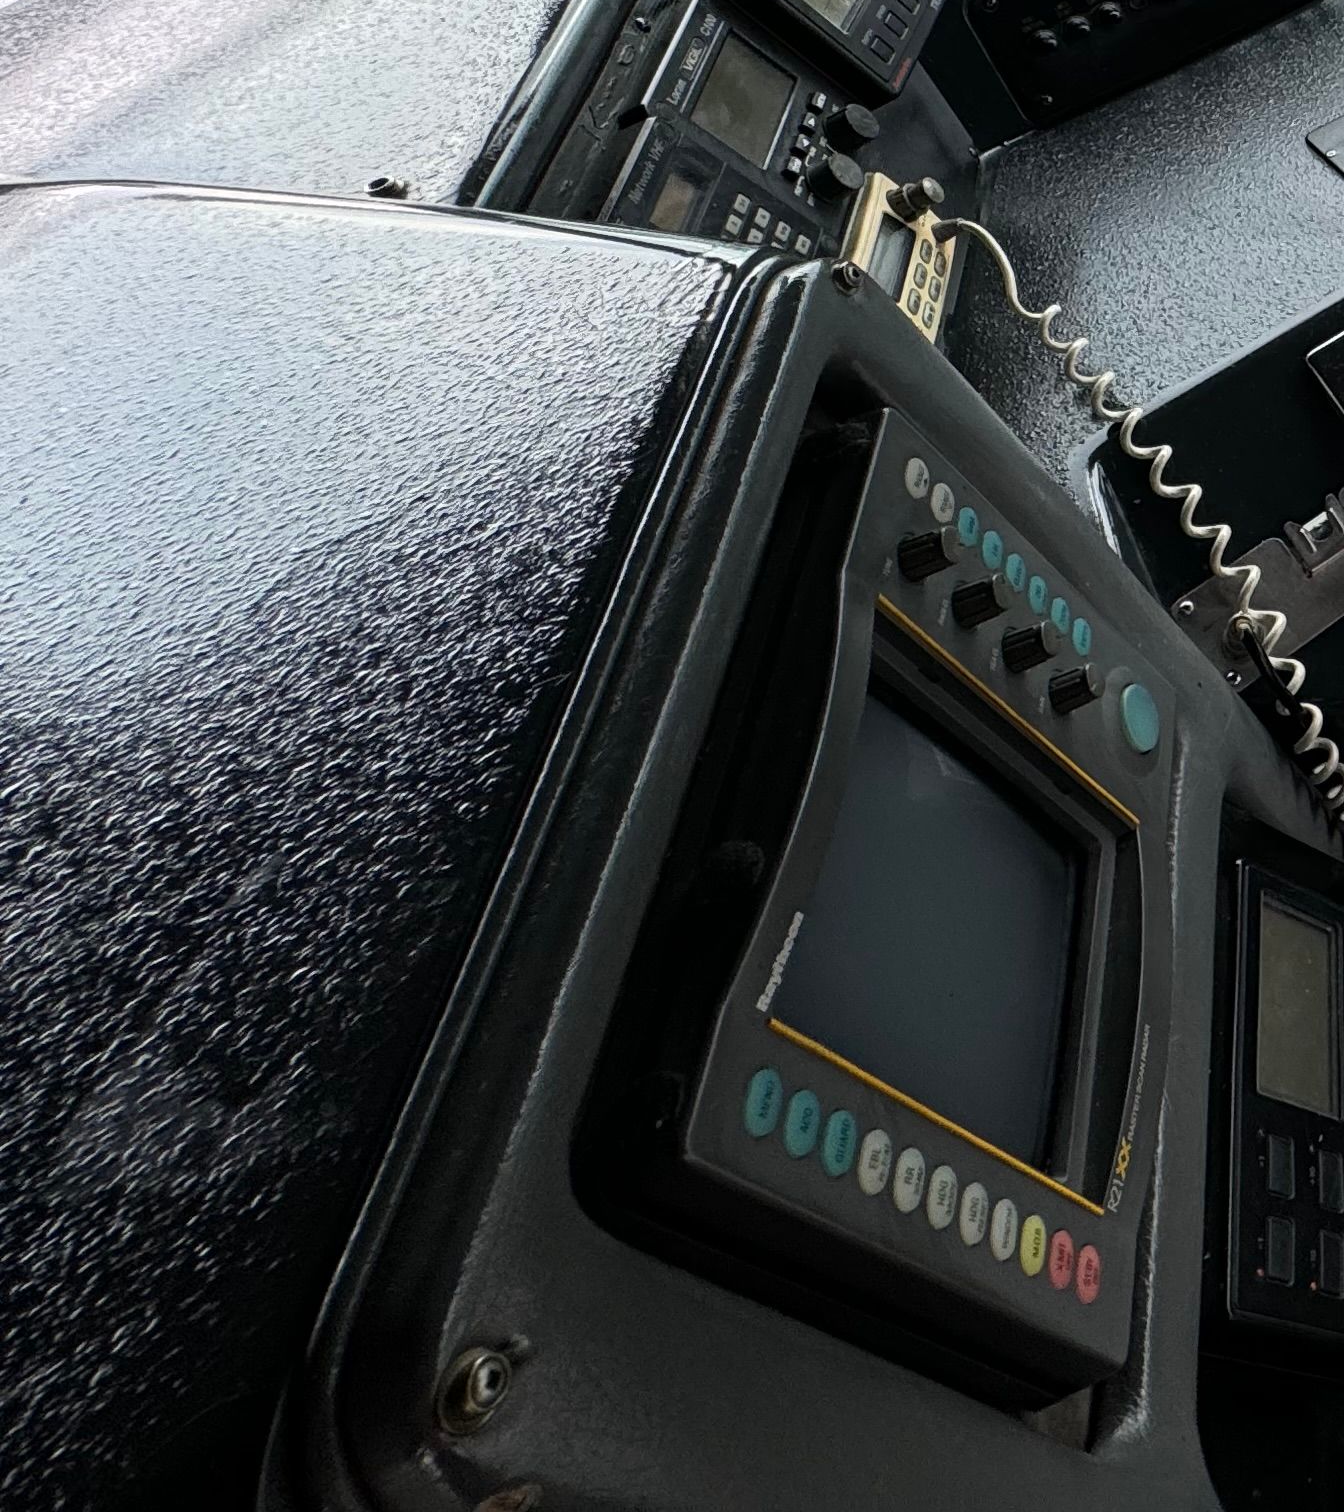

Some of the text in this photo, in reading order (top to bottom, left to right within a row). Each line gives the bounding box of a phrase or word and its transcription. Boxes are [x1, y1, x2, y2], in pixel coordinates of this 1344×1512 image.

[627, 159, 656, 205] Network
[756, 911, 804, 1012] Raytheon
[834, 1117, 850, 1164] GUARD
